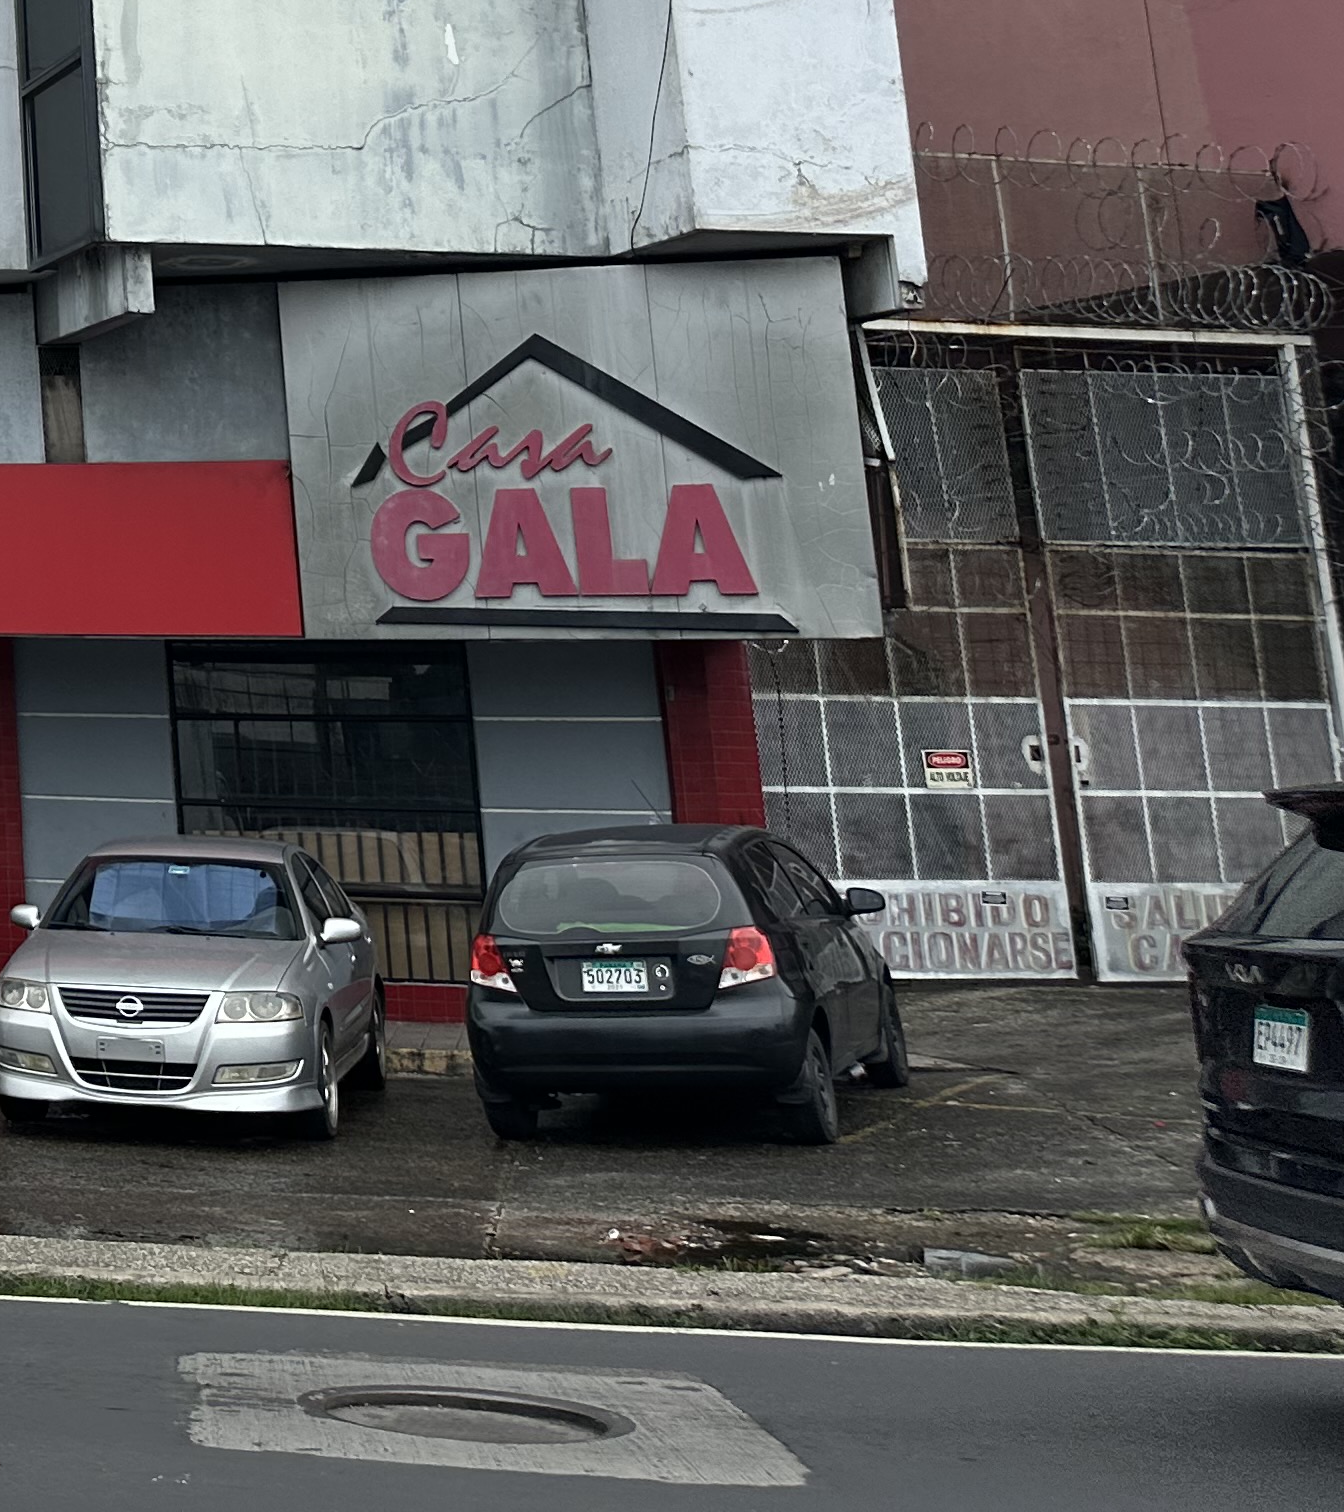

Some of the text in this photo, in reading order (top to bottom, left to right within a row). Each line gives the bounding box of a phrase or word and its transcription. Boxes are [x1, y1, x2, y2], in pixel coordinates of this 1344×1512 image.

[388, 400, 612, 487] Casa
[370, 483, 759, 601] GALA
[862, 892, 1050, 928] HIBIDO
[879, 931, 1075, 971] CIONARSE
